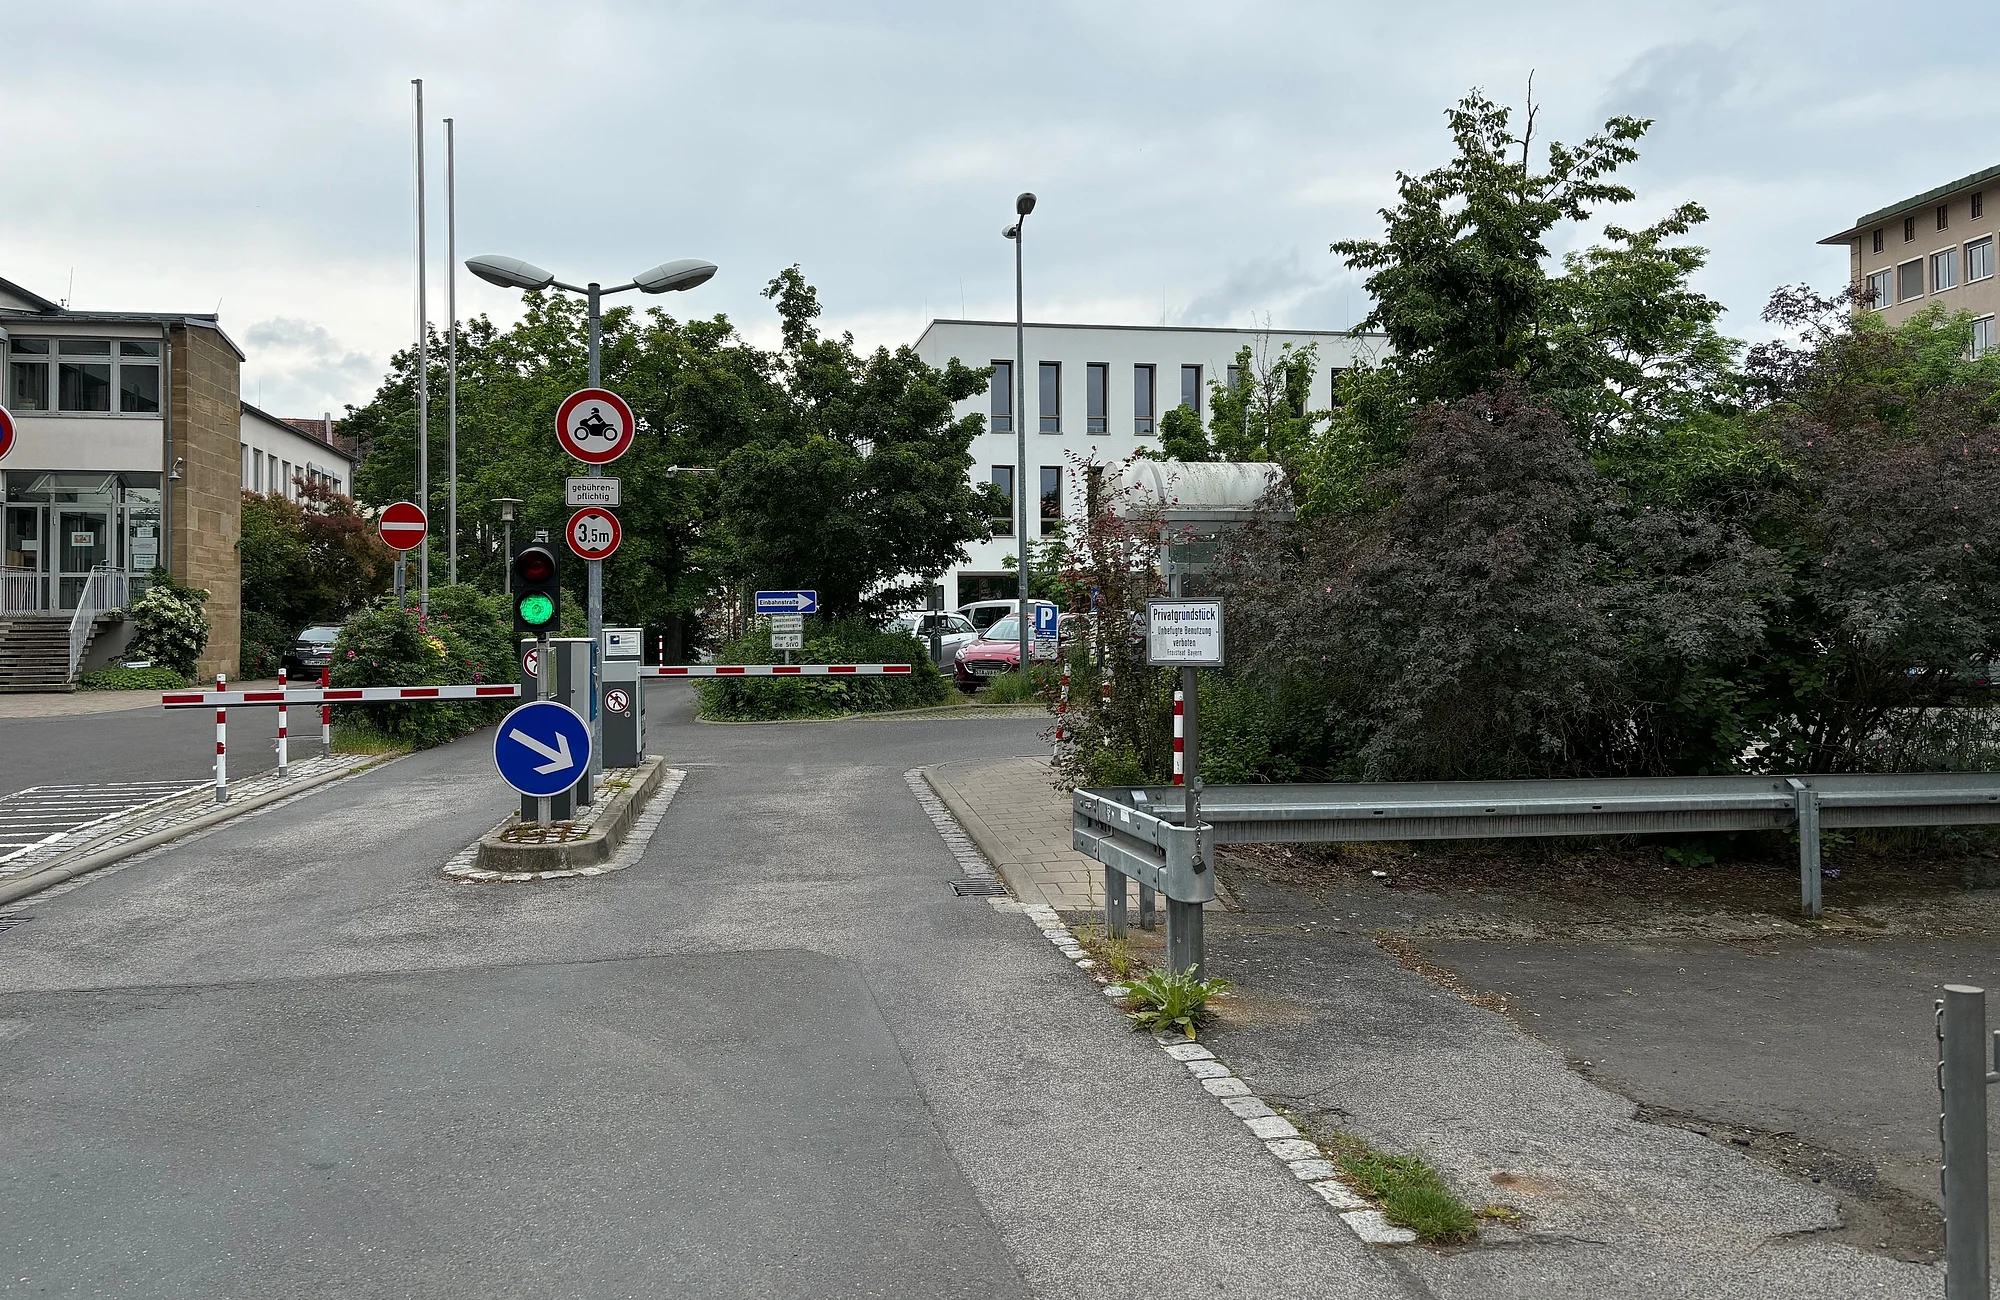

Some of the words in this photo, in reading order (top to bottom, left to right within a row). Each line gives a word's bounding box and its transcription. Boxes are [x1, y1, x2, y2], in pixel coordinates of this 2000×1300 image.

[572, 484, 614, 492] gebühren-
[577, 493, 609, 501] pflichtig
[1040, 607, 1053, 629] P
[1153, 607, 1216, 623] Privatgrundstück
[1157, 626, 1183, 637] Unbefugte
[1184, 625, 1212, 637] Benutzung
[1172, 638, 1197, 647] verboten
[1187, 648, 1203, 657] Bayern
